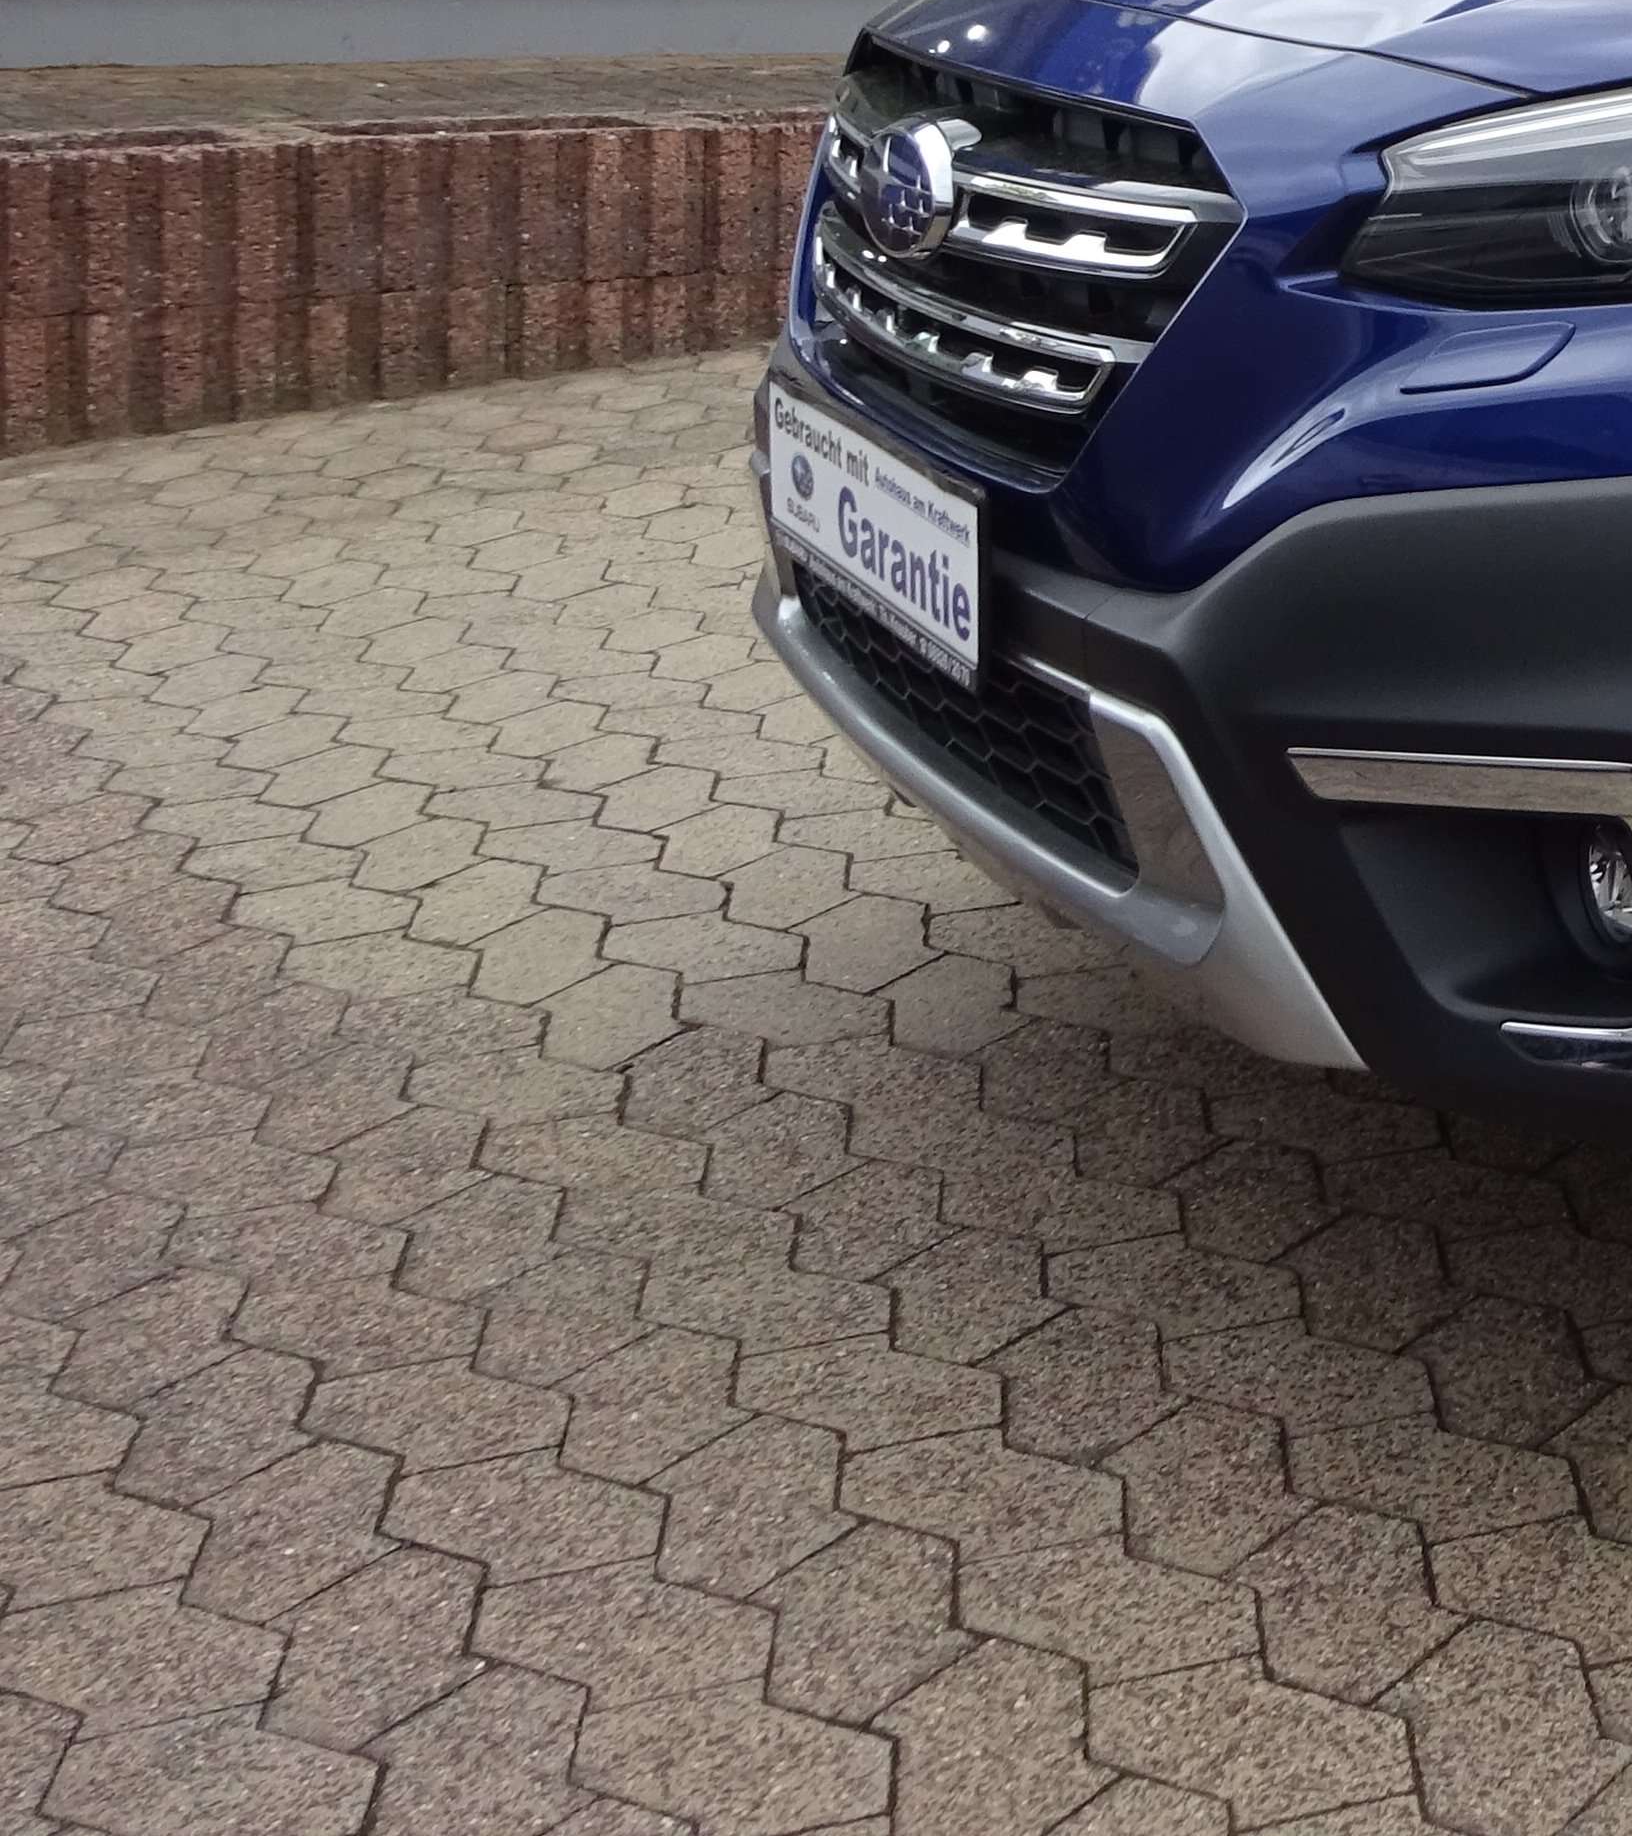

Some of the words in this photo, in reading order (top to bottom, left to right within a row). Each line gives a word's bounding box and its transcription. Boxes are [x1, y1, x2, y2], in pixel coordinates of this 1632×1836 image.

[774, 397, 842, 469] Gebraucht
[846, 449, 870, 487] mit
[838, 485, 972, 641] Garantie
